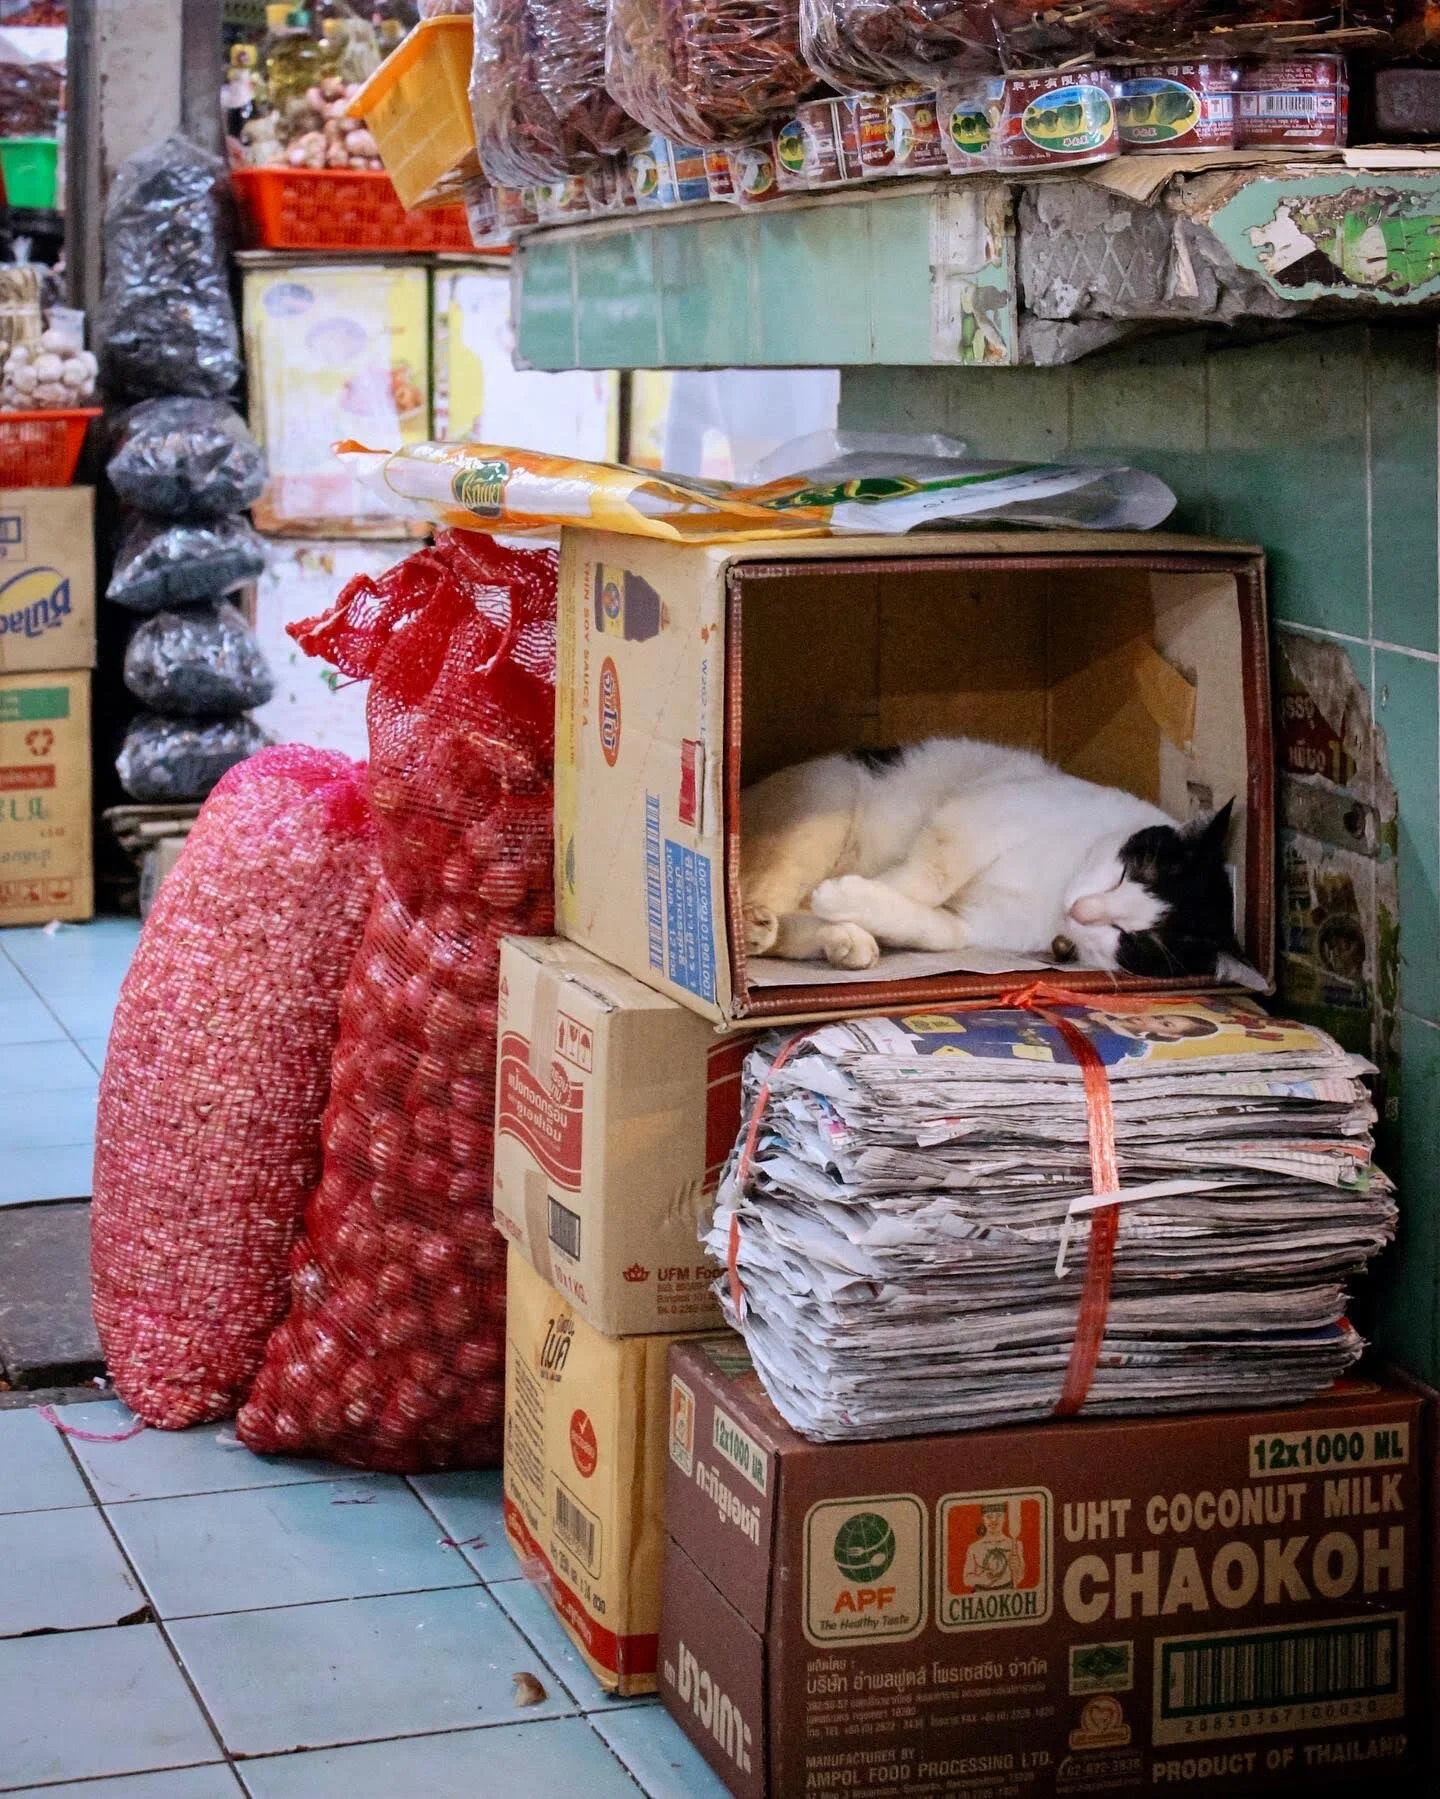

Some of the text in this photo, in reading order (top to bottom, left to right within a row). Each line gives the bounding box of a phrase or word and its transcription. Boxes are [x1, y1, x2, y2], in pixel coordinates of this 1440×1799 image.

[583, 561, 591, 600] THIN
[583, 607, 591, 642] SOY
[583, 648, 591, 708] SAUCE
[657, 1267, 690, 1281] UFM
[1254, 1429, 1404, 1470] 12x1000 ML
[1063, 1473, 1404, 1543] UHT COCONUT MILK
[1063, 1525, 1405, 1625] CHAOKOH
[833, 1586, 897, 1614] APF
[949, 1591, 1037, 1622] CHAOKOH
[819, 1614, 911, 1631] The Healthy Taste
[807, 1672, 848, 1695] บริษัท
[1008, 1656, 1048, 1677] จำกัด
[677, 1640, 753, 1776] ชาวเกาะ
[806, 1751, 896, 1768] MANUFACTURER
[900, 1748, 917, 1761] BY
[806, 1768, 862, 1789] AMPOL
[869, 1764, 912, 1783] FOOD
[918, 1753, 1014, 1778] PROCESSING
[1021, 1751, 1054, 1769] LTD.
[1152, 1734, 1408, 1784] PRODUCT OF THAILAND
